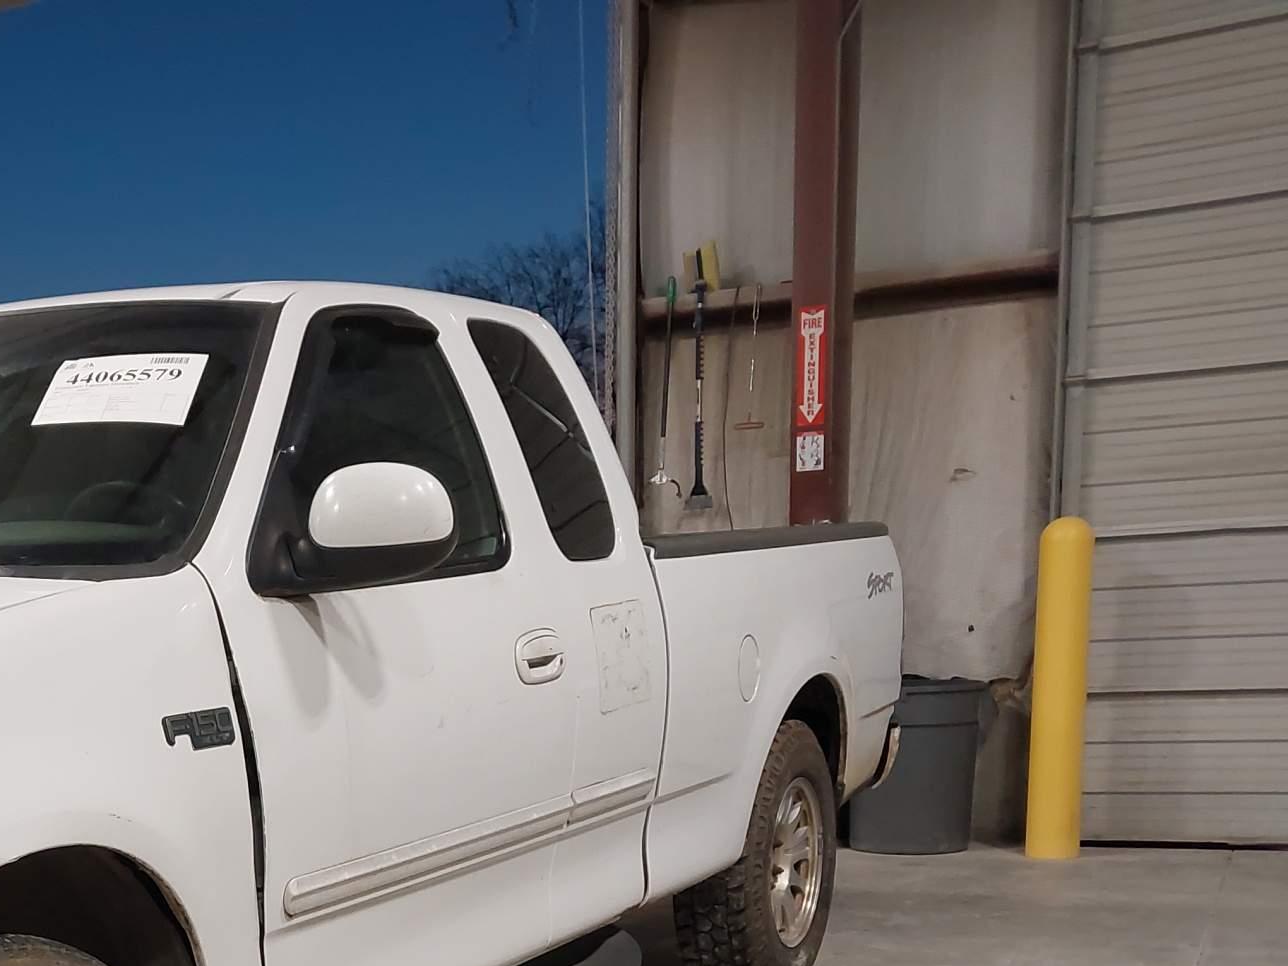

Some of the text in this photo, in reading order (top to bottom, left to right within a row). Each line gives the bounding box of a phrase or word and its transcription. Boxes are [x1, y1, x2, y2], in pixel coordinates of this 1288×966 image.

[803, 317, 822, 329] FIRE
[65, 368, 184, 386] 44065579
[807, 333, 816, 416] EXTINGUISHER
